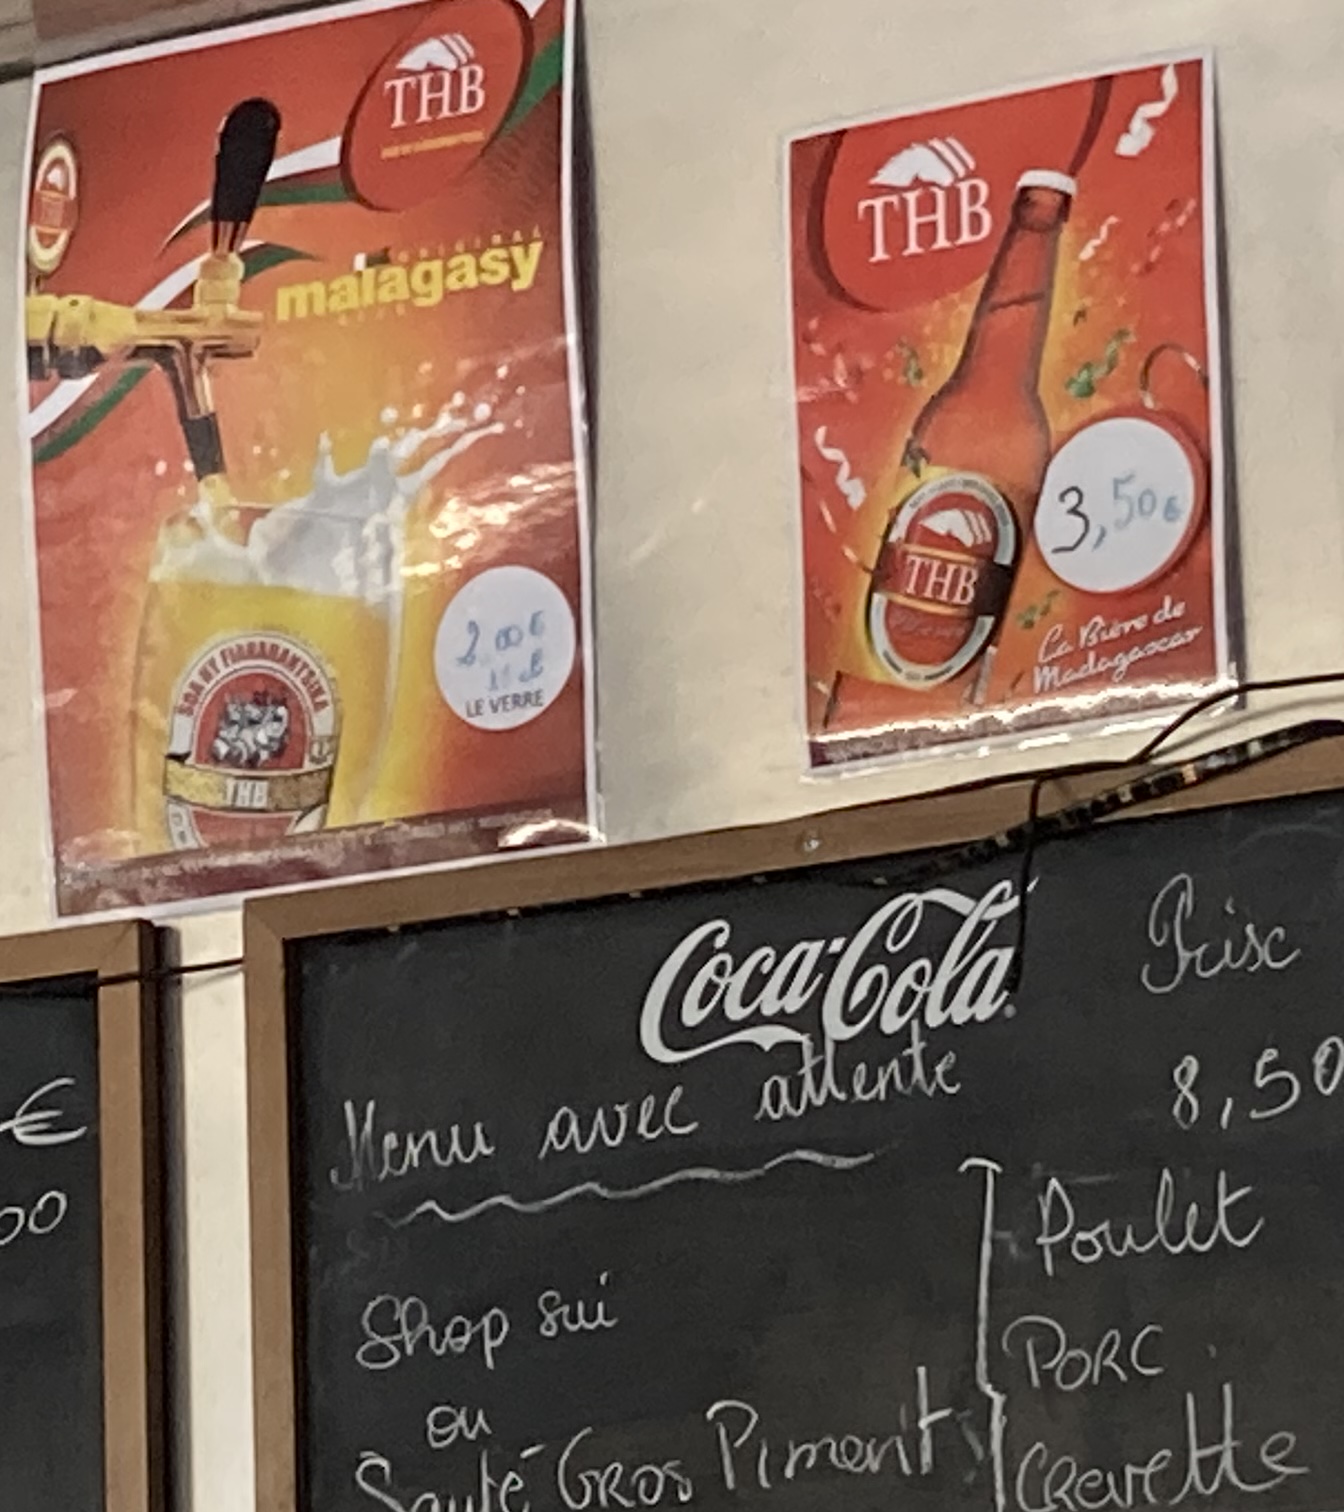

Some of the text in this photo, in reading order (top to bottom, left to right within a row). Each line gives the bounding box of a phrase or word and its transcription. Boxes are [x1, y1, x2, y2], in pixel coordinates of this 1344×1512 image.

[382, 64, 485, 129] THB
[858, 178, 992, 264] THB
[275, 241, 545, 322] malagasy
[904, 556, 979, 605] THB
[1034, 1168, 1266, 1276] Poulet
